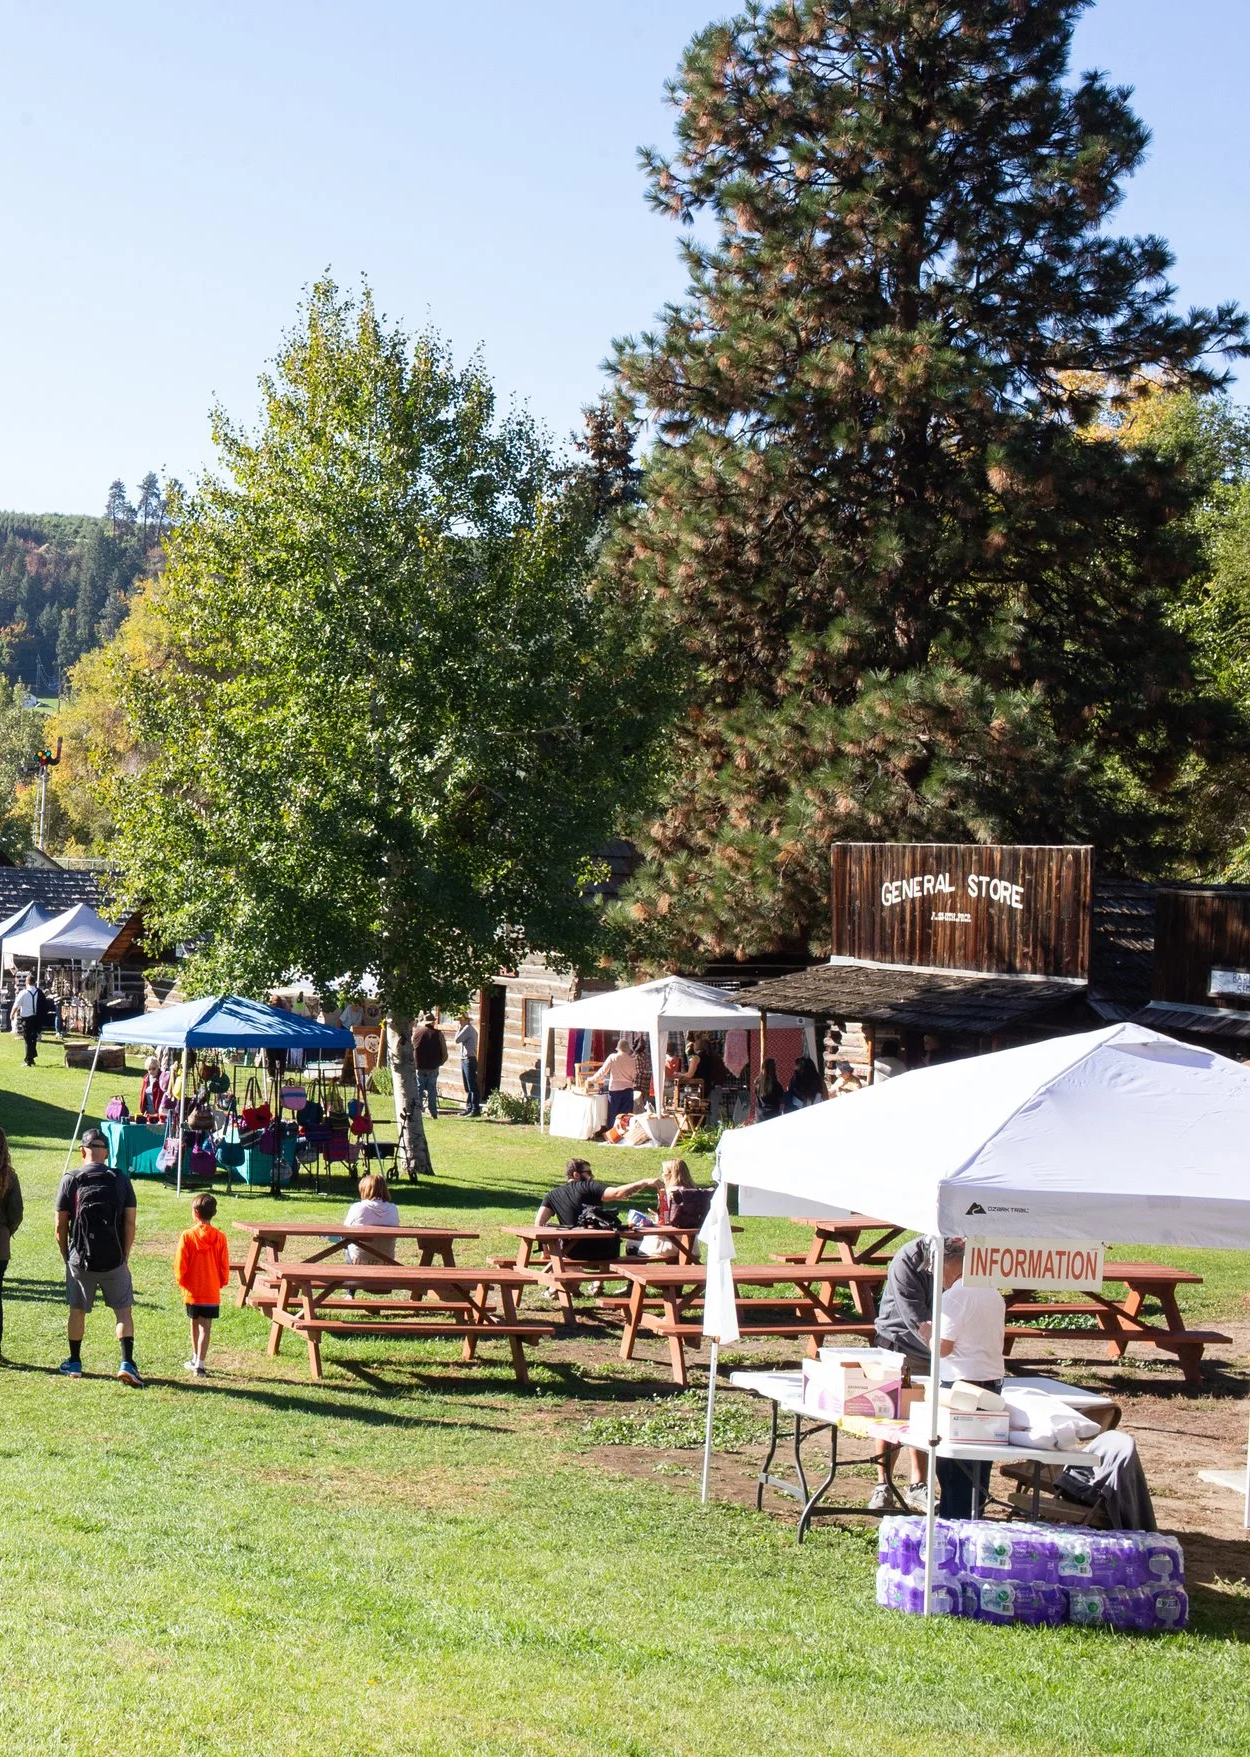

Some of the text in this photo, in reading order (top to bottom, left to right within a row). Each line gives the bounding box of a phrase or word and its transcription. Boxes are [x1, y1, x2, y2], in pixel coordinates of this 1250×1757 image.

[881, 873, 1024, 909] GENERAL STORE
[1232, 972, 1250, 984] BAR
[970, 1247, 1097, 1280] INFORMATION
